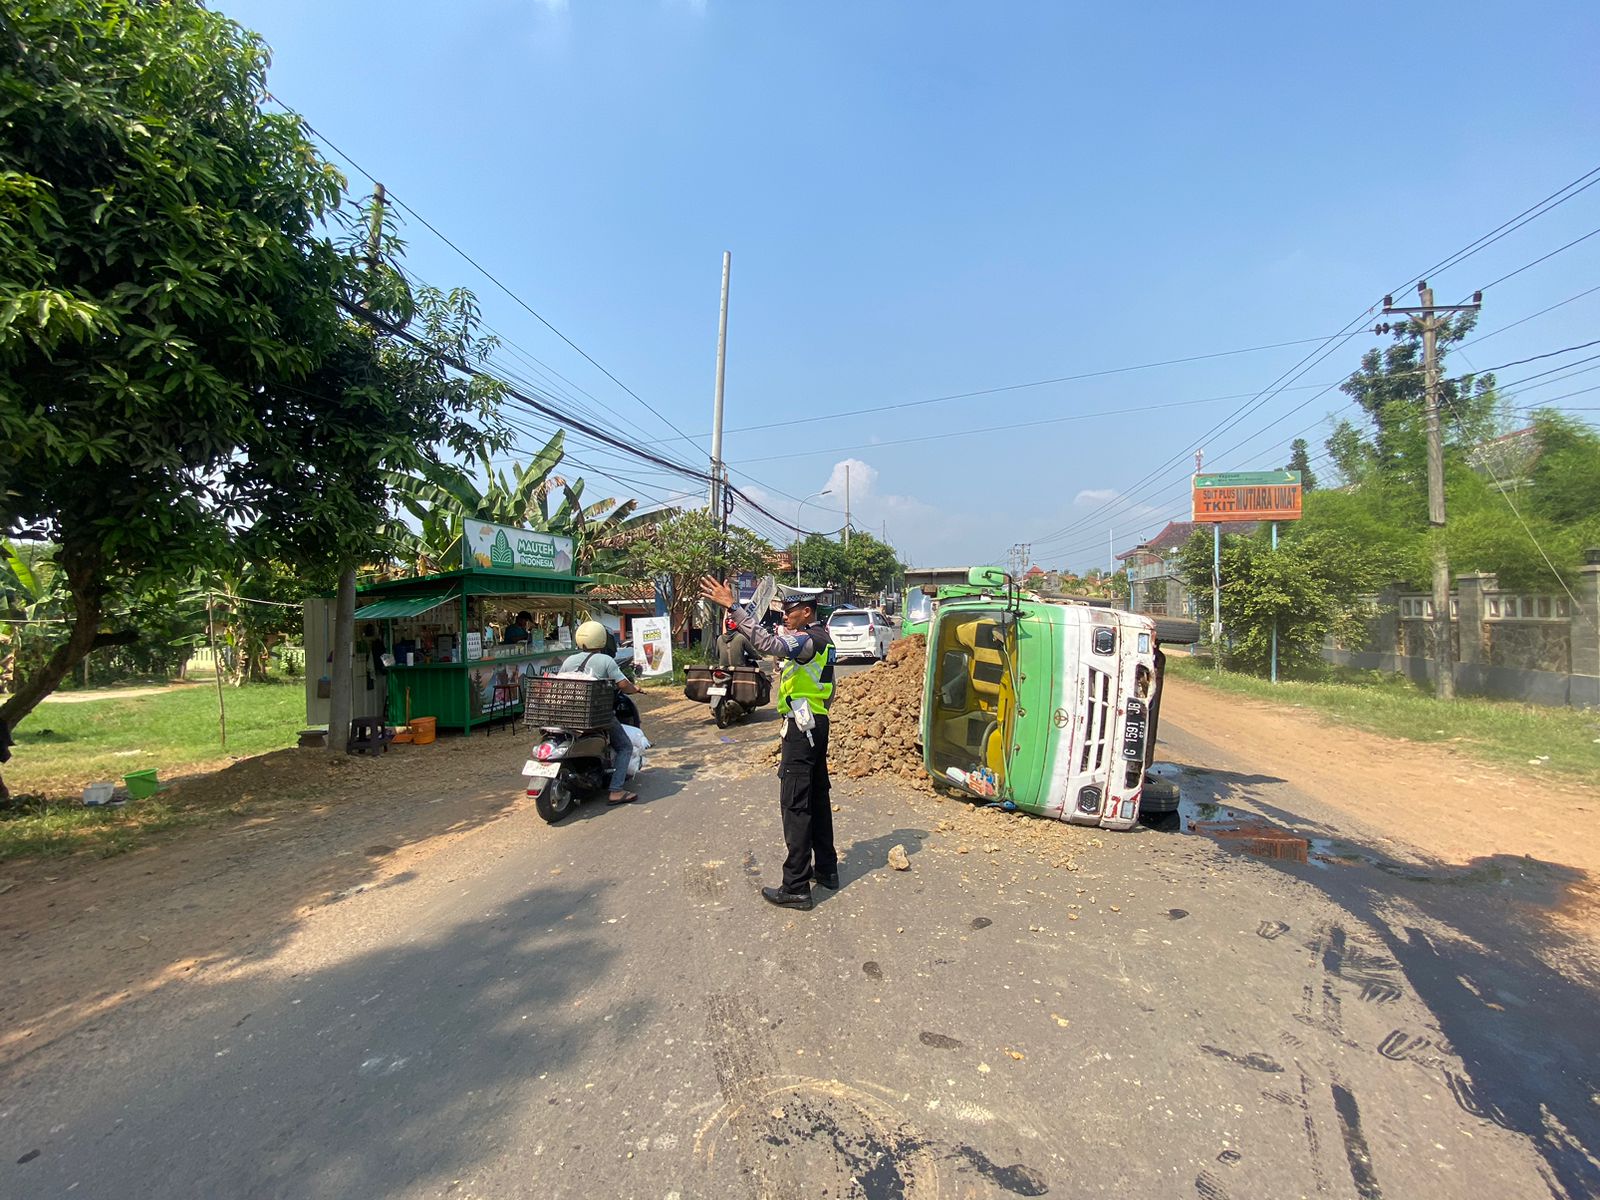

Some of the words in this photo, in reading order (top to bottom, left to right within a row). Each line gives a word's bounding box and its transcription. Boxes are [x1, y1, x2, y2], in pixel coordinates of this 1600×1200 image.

[1219, 489, 1235, 499] PLUS
[1236, 488, 1272, 510] MUTIARA
[1275, 488, 1296, 509] UMAT
[1203, 501, 1235, 512] TKIT
[518, 540, 554, 556] MAUTEH
[521, 557, 554, 568] INDONESIA
[1128, 702, 1140, 714] JB
[1125, 722, 1138, 743] 1591
